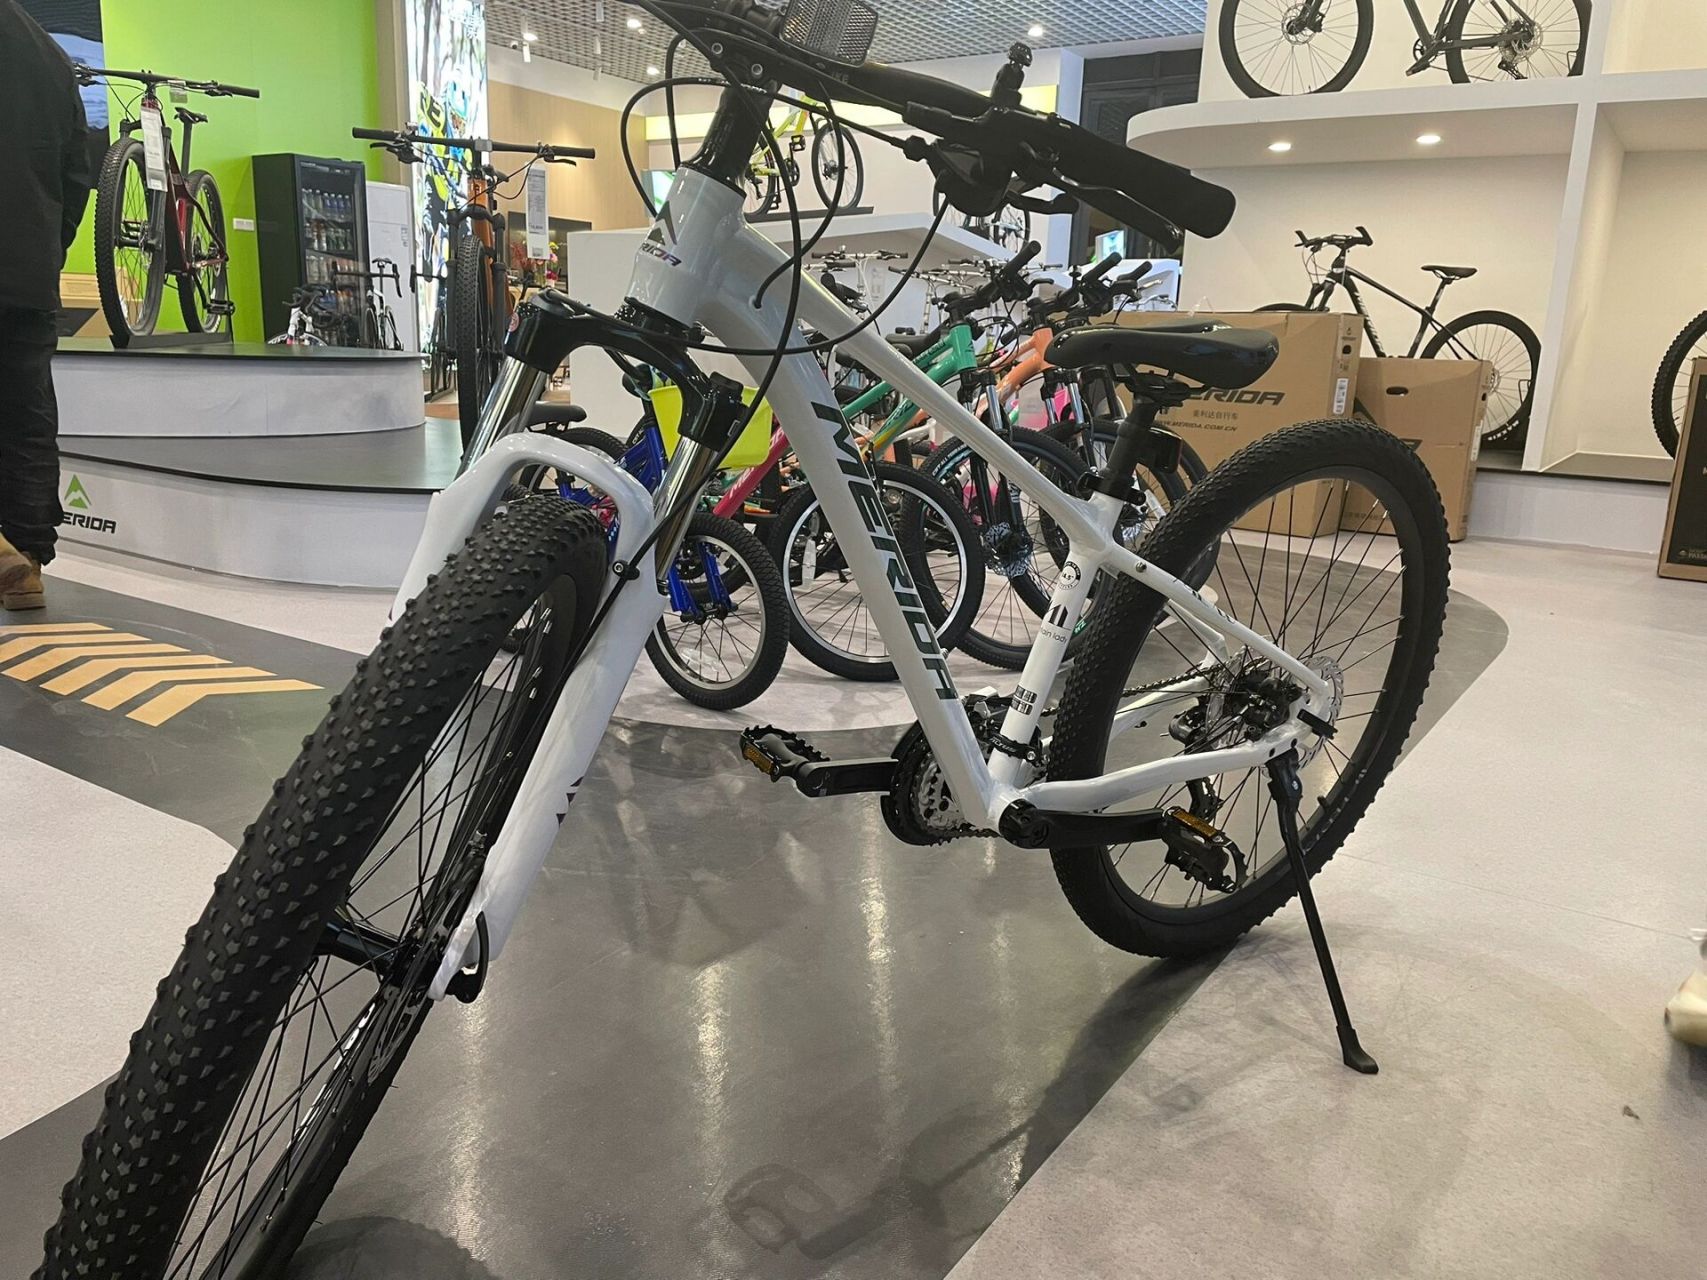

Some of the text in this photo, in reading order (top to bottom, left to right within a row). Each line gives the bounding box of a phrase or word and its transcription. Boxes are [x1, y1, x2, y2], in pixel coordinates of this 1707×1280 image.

[640, 242, 682, 267] RIDA
[1189, 388, 1286, 406] RIDA
[62, 511, 117, 534] ERIDA
[810, 401, 961, 701] MERIDA
